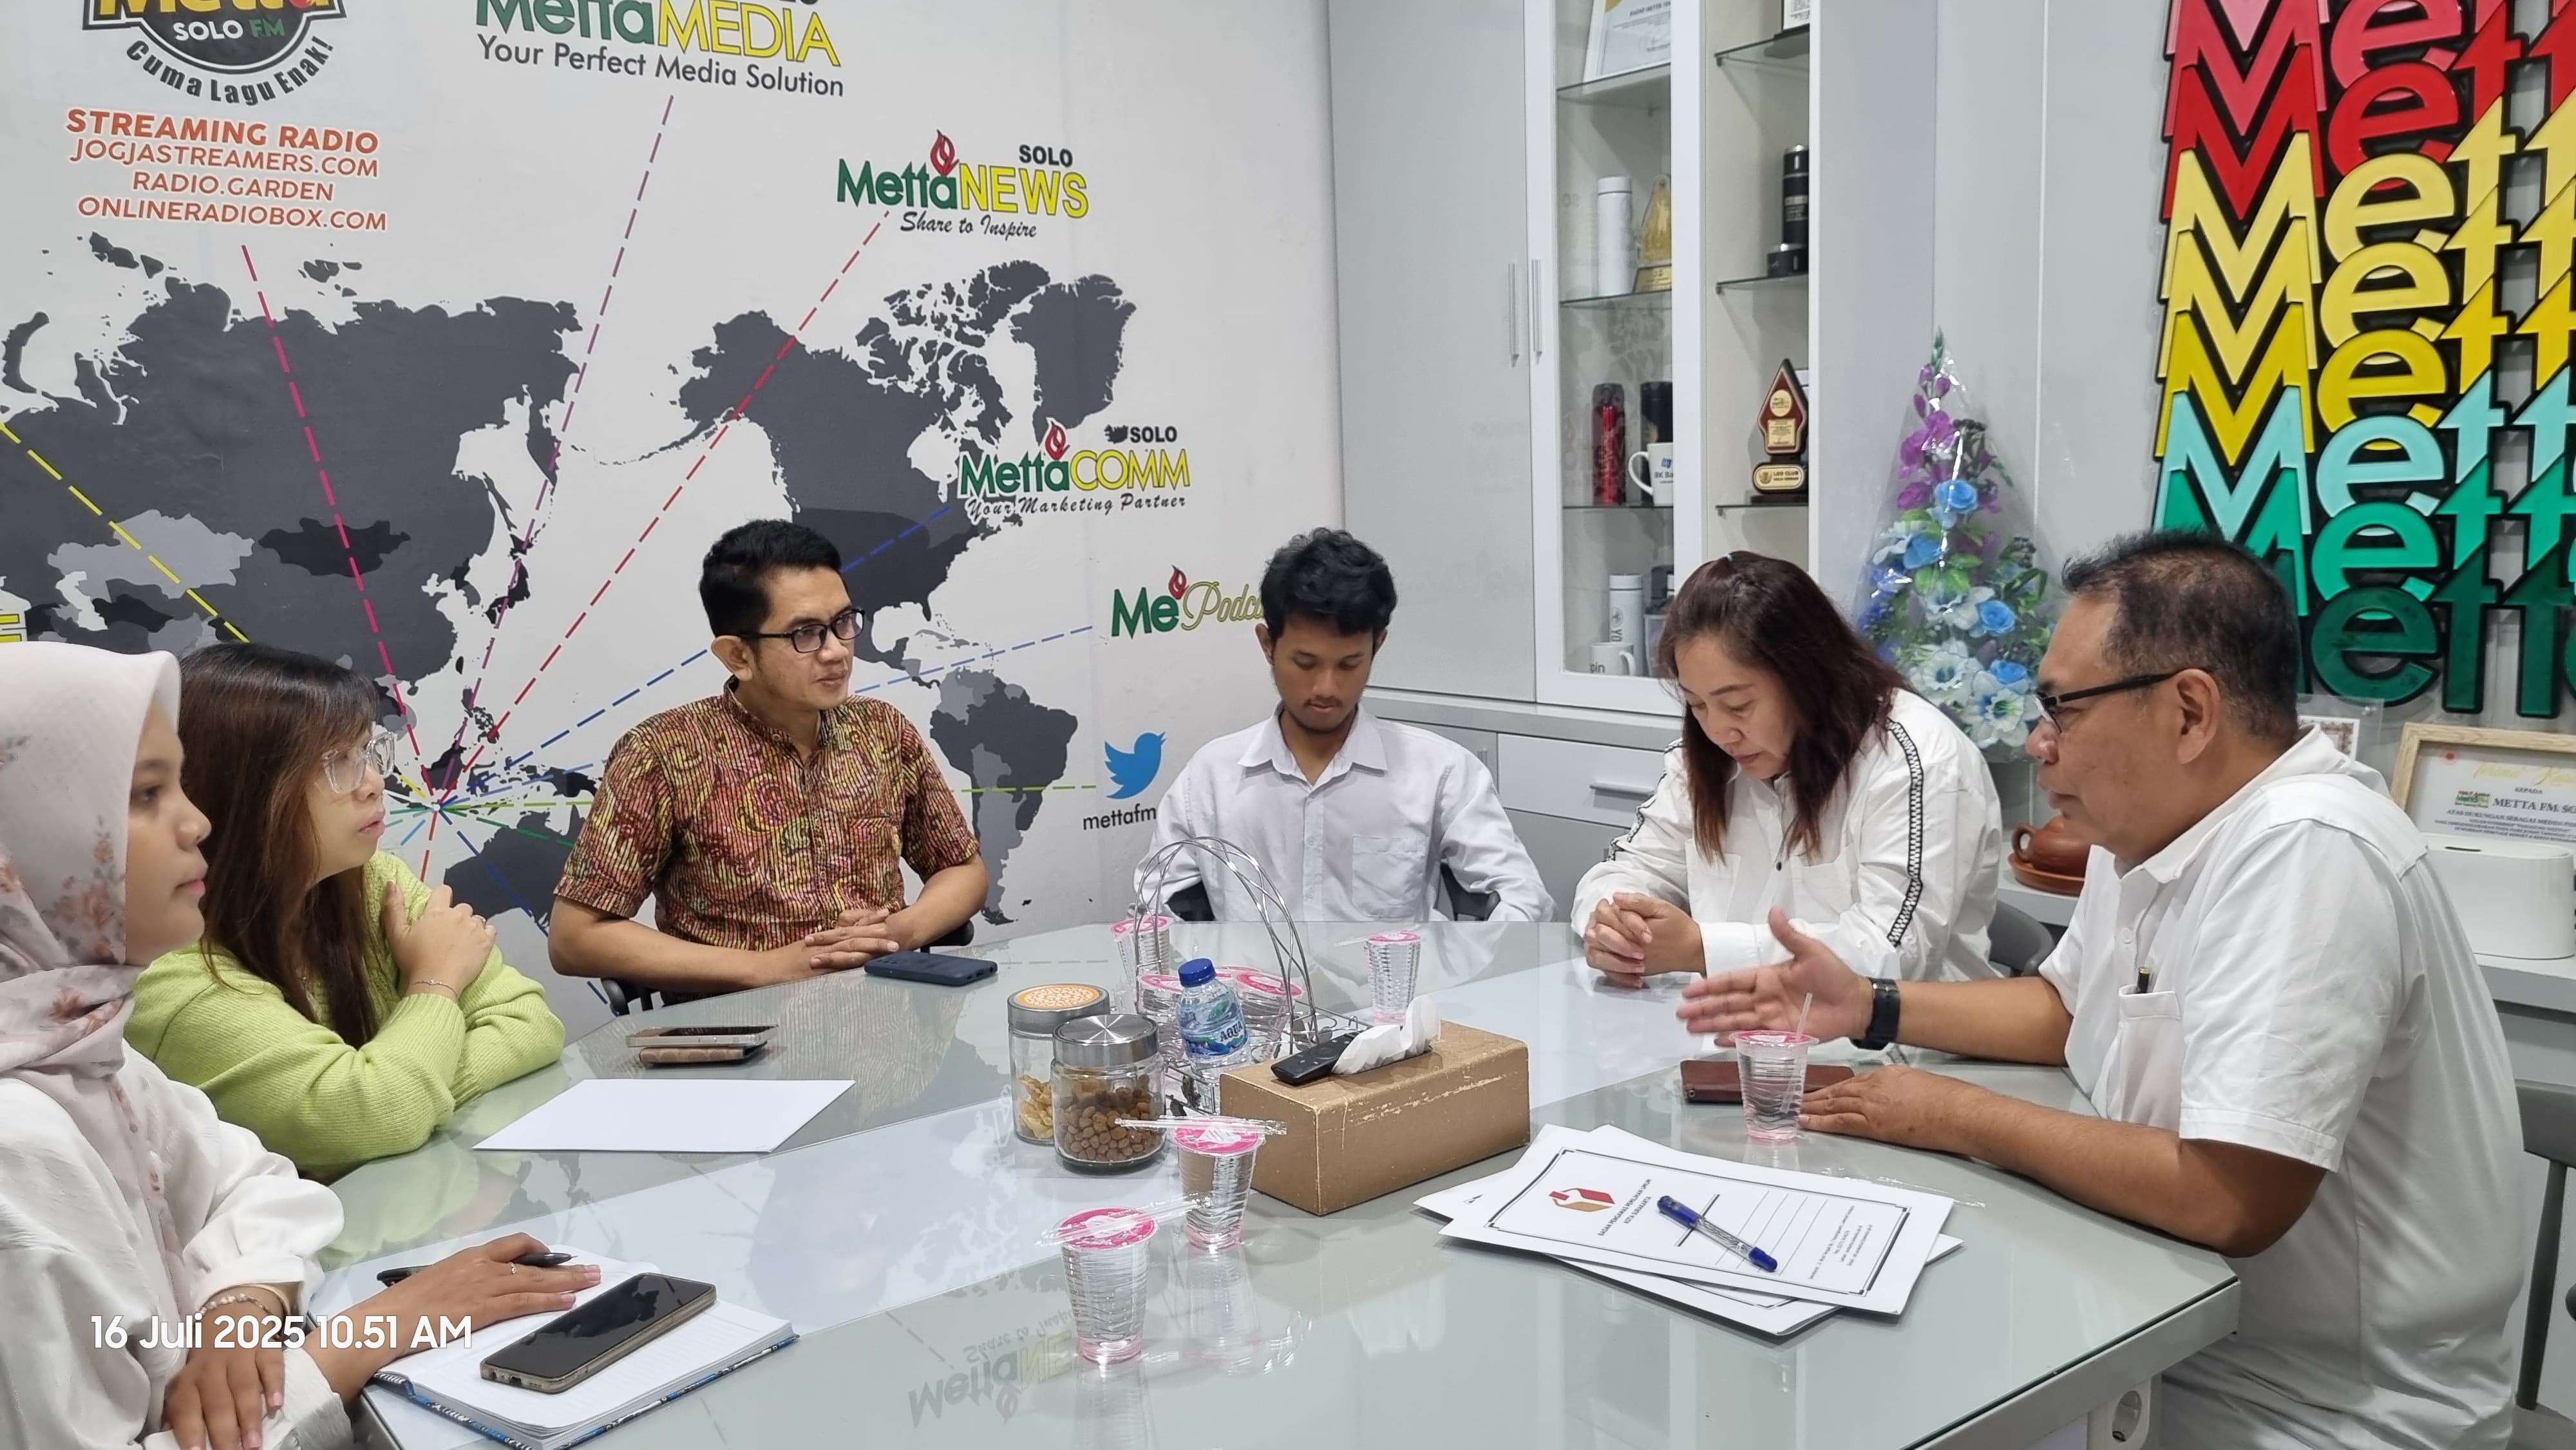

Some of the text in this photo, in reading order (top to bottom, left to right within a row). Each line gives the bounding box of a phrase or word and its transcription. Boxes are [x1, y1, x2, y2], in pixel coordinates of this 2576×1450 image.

[173, 17, 286, 41] SOLO FM
[126, 36, 334, 106] Cuma Lagu Enak!
[477, 33, 844, 97] Your Perfect Media Solution
[66, 108, 379, 154] STREAMING RADIO
[70, 138, 378, 177] JOGJASTREAMERS.COM
[1019, 145, 1073, 167] SOLO
[133, 171, 334, 201] RADIO.GARDEN
[837, 158, 1089, 219] MettaNEWS
[78, 196, 386, 231] ONLINERADIOBOX.COM
[900, 211, 1037, 241] Share to Inspire
[1130, 426, 1178, 443] SOLO
[2153, 365, 2576, 542] Mett
[960, 449, 1191, 496] MettaCOMM
[967, 493, 1187, 522] Your Marketing Partner
[1083, 803, 1157, 830] mettafm
[2492, 797, 2537, 811] METTA
[1220, 1021, 1244, 1042] AQUA
